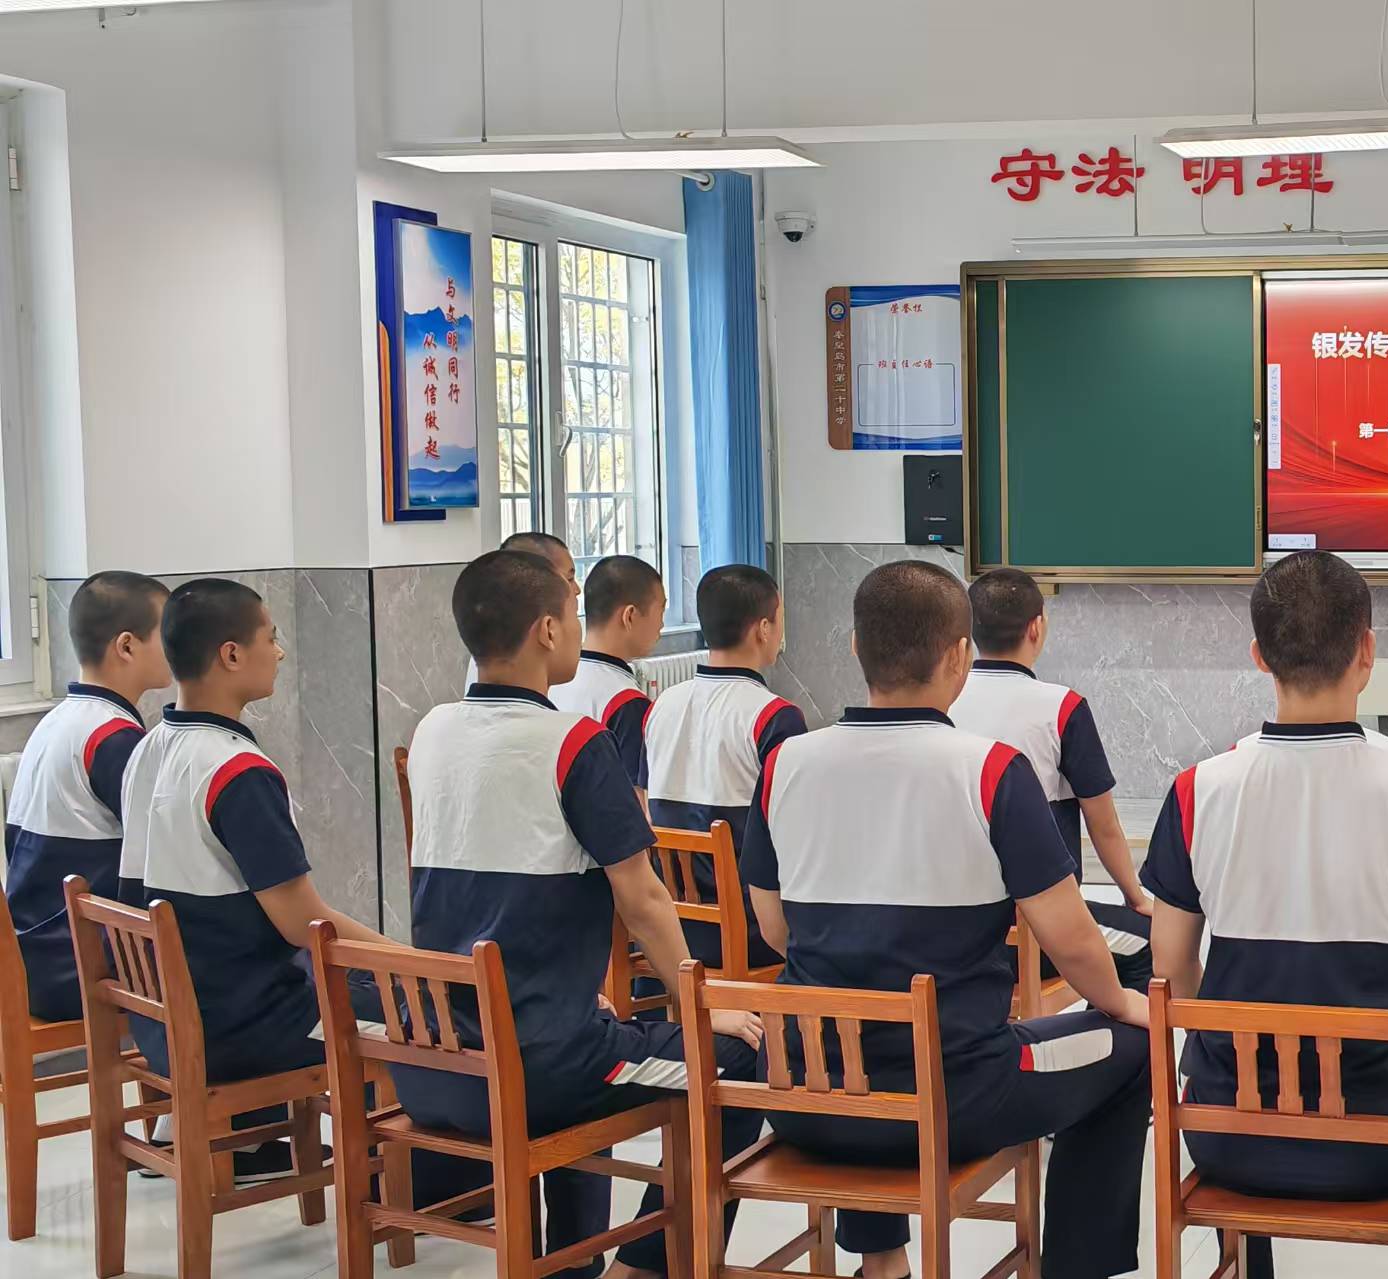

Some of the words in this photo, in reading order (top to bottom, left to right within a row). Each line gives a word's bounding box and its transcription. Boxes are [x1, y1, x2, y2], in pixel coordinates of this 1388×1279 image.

[991, 147, 1145, 202] 守法
[1182, 156, 1335, 197] 明理
[423, 332, 440, 460] 从诚信做起
[445, 277, 461, 404] 与文明同行
